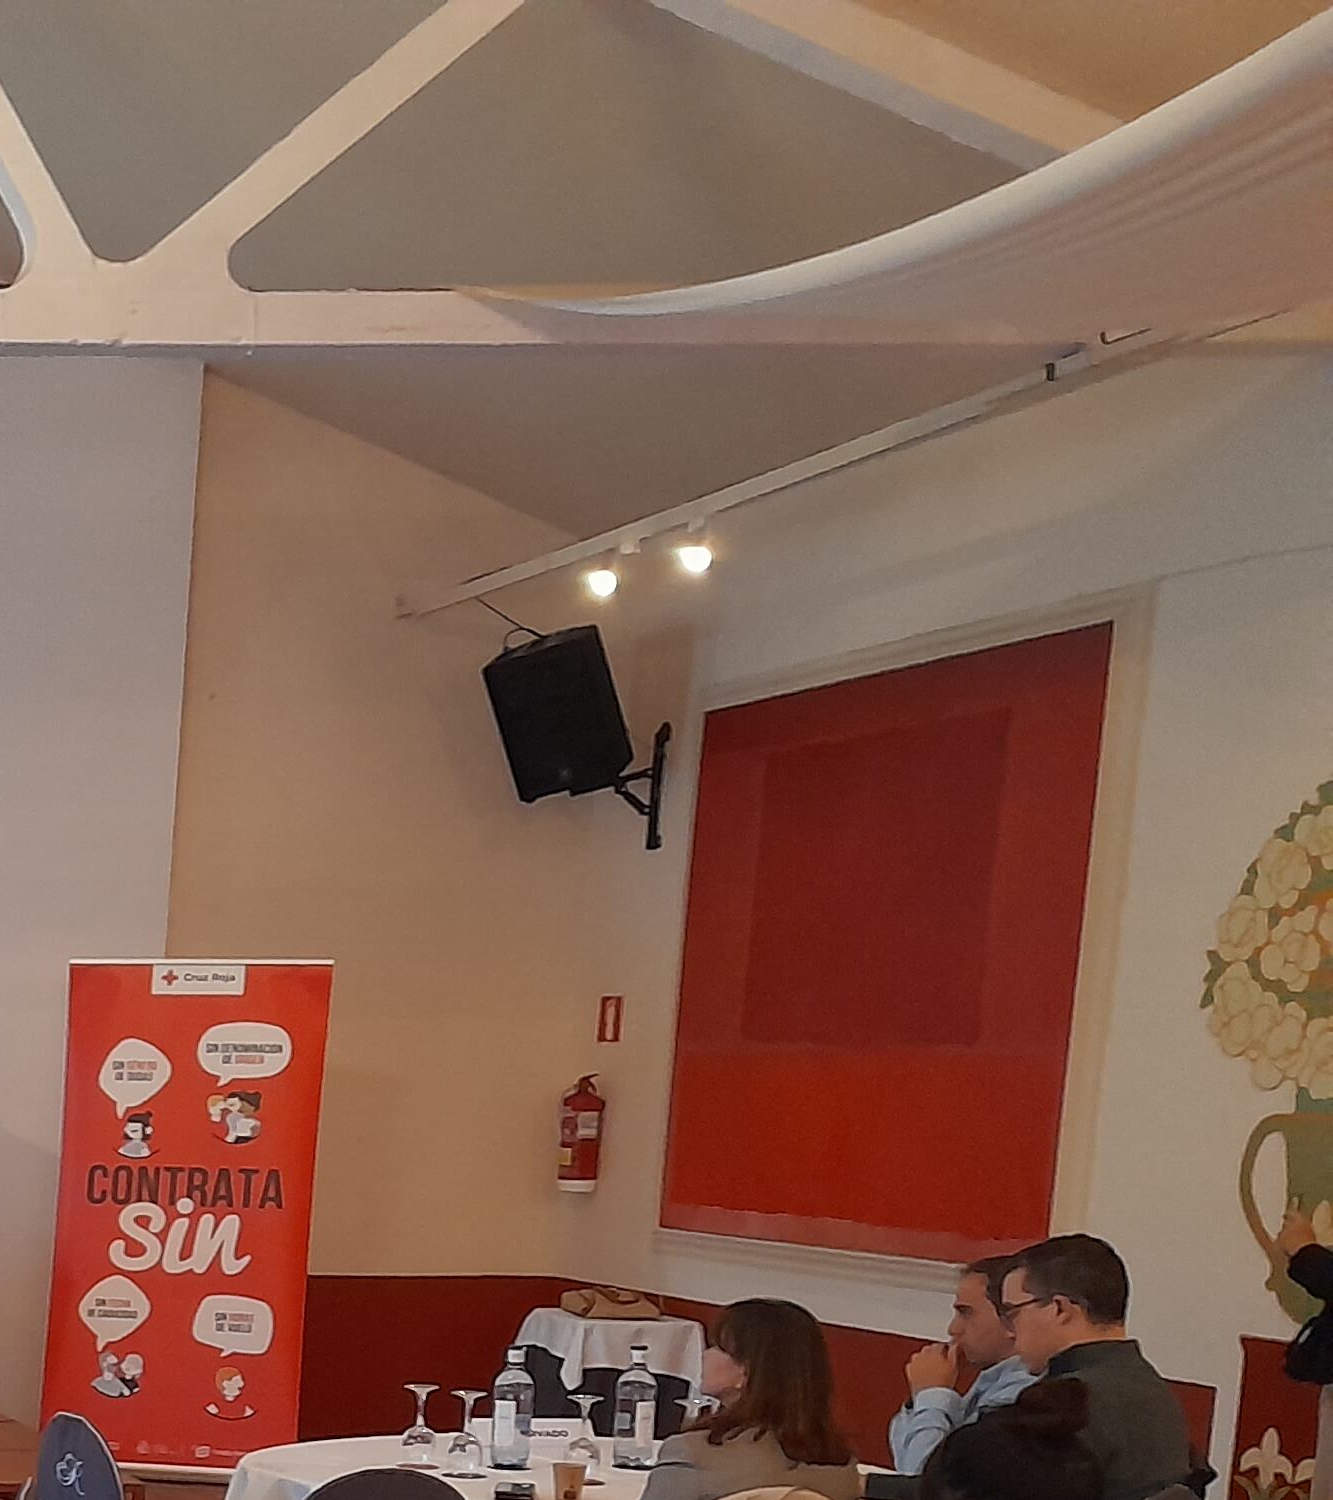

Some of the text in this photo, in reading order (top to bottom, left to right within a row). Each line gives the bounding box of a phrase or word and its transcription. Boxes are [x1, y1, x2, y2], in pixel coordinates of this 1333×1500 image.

[183, 972, 236, 985] Cruz Roja
[86, 1164, 284, 1210] CONTRATA
[108, 1197, 252, 1276] Sin
